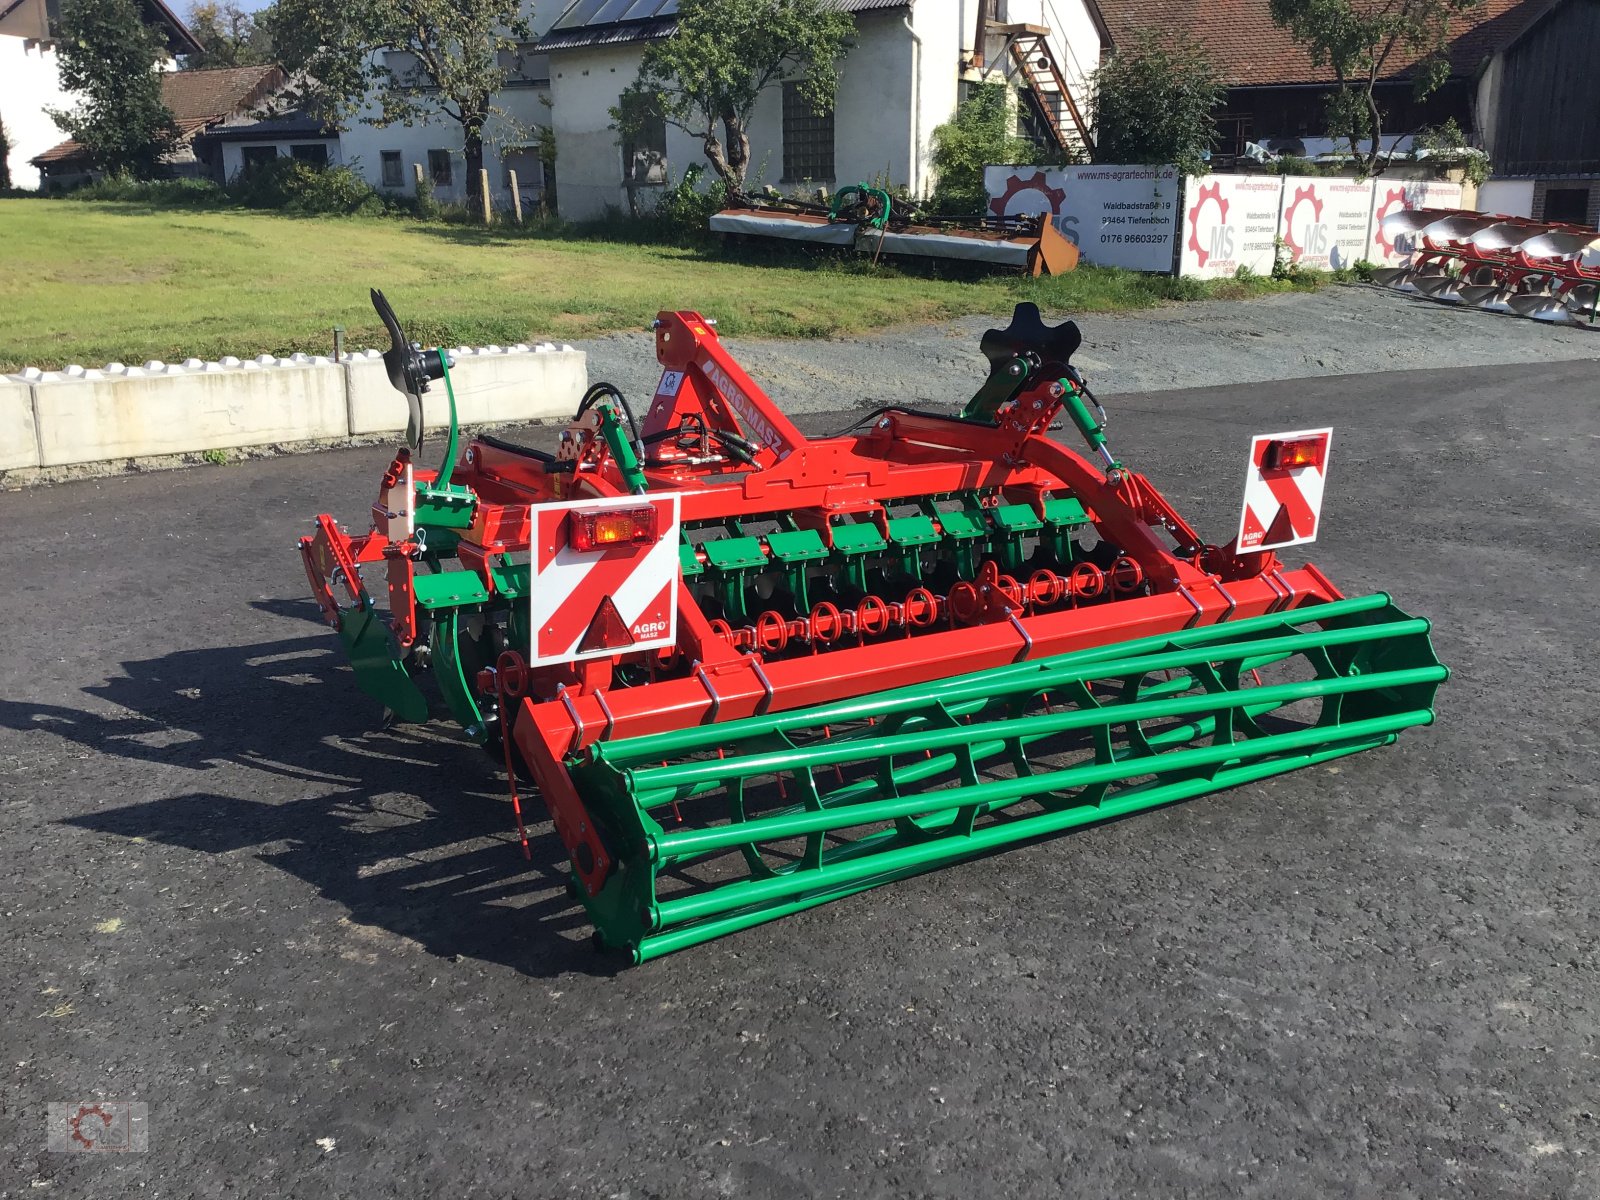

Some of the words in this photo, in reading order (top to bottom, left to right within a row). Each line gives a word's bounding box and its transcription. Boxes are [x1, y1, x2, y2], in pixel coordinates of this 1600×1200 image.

[1077, 169, 1173, 181] www.ms-agrartechnik.de
[1161, 202, 1171, 210] 19
[1102, 216, 1126, 224] 93464
[1128, 216, 1170, 224] Tiefenbach
[1100, 234, 1122, 244] 0176
[1124, 234, 1168, 244] 96603297
[1209, 225, 1235, 260] MS
[1304, 223, 1328, 255] MS
[711, 367, 782, 453] AGRO-MASZ
[1243, 531, 1263, 541] AGRO
[633, 621, 666, 635] AGRO
[640, 631, 658, 640] MASZ
